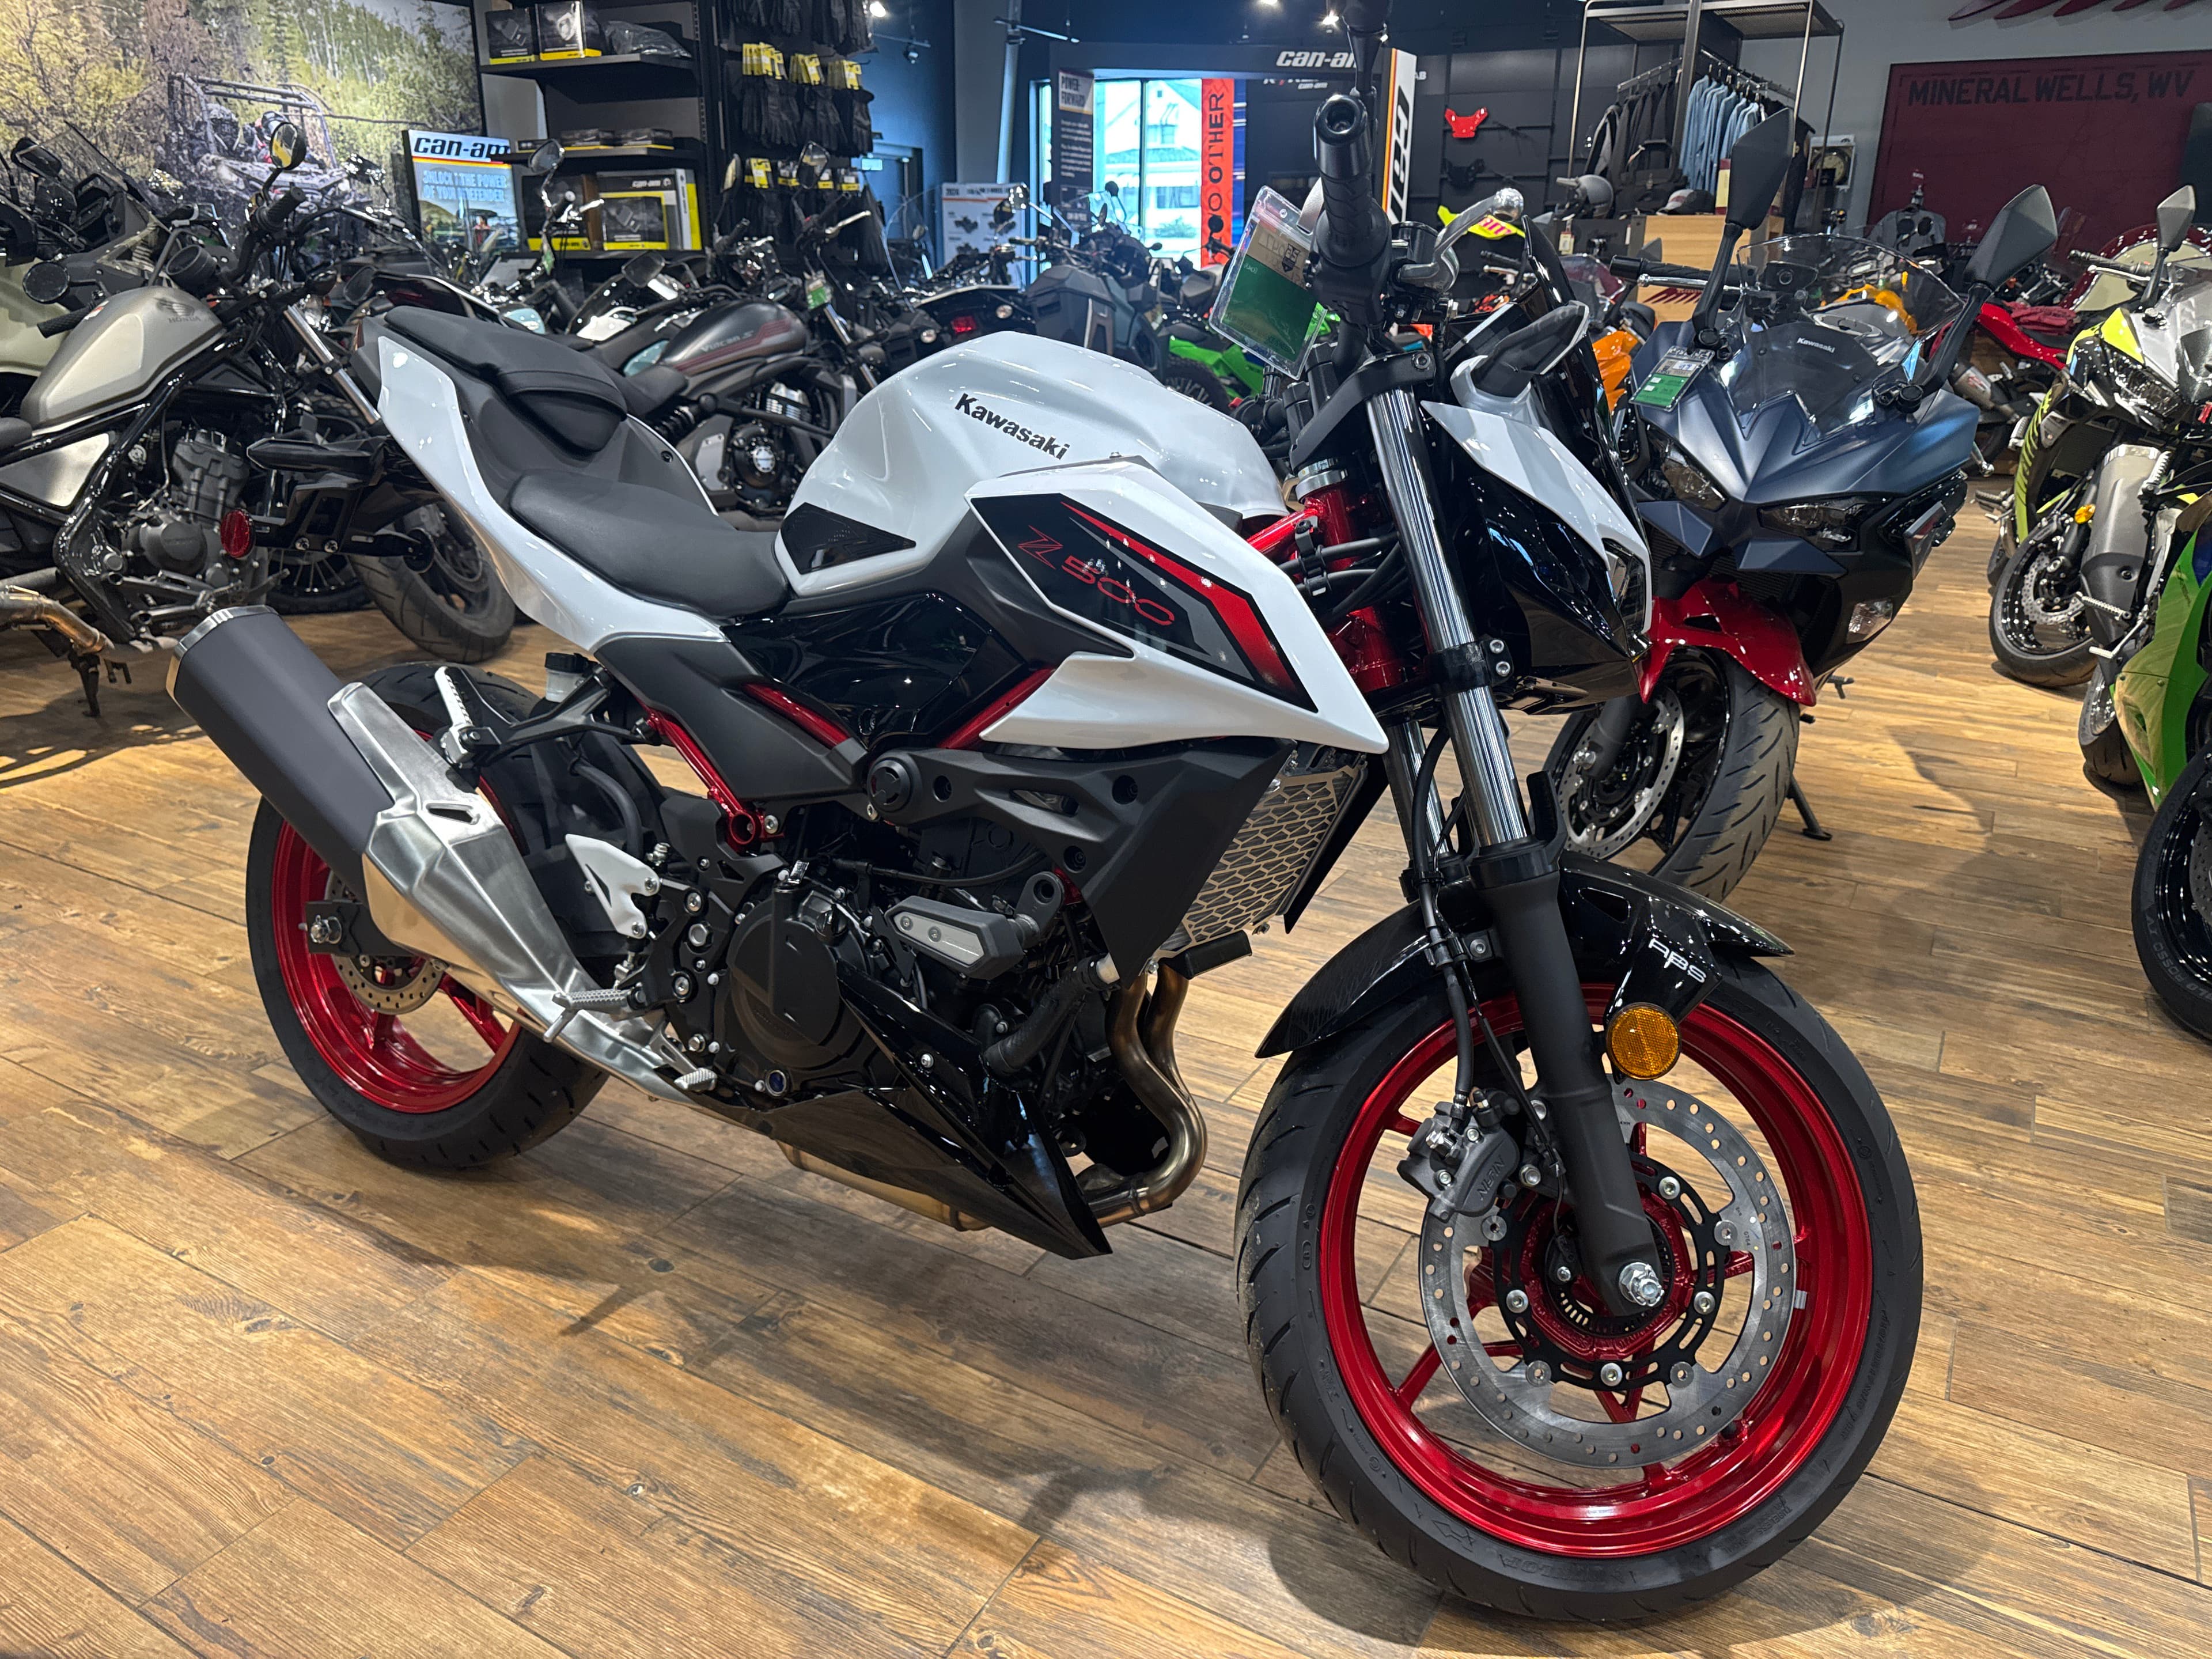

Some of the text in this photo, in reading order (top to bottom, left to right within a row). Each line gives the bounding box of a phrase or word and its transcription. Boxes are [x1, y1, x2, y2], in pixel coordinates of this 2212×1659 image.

[1908, 70, 2194, 106] MINERAL WELLS, WV
[414, 137, 511, 158] can-am
[1208, 93, 1225, 184] OTHER
[1797, 337, 1836, 354] Kawasaki
[955, 392, 1070, 460] Kawasaki
[1648, 938, 1707, 983] ABS
